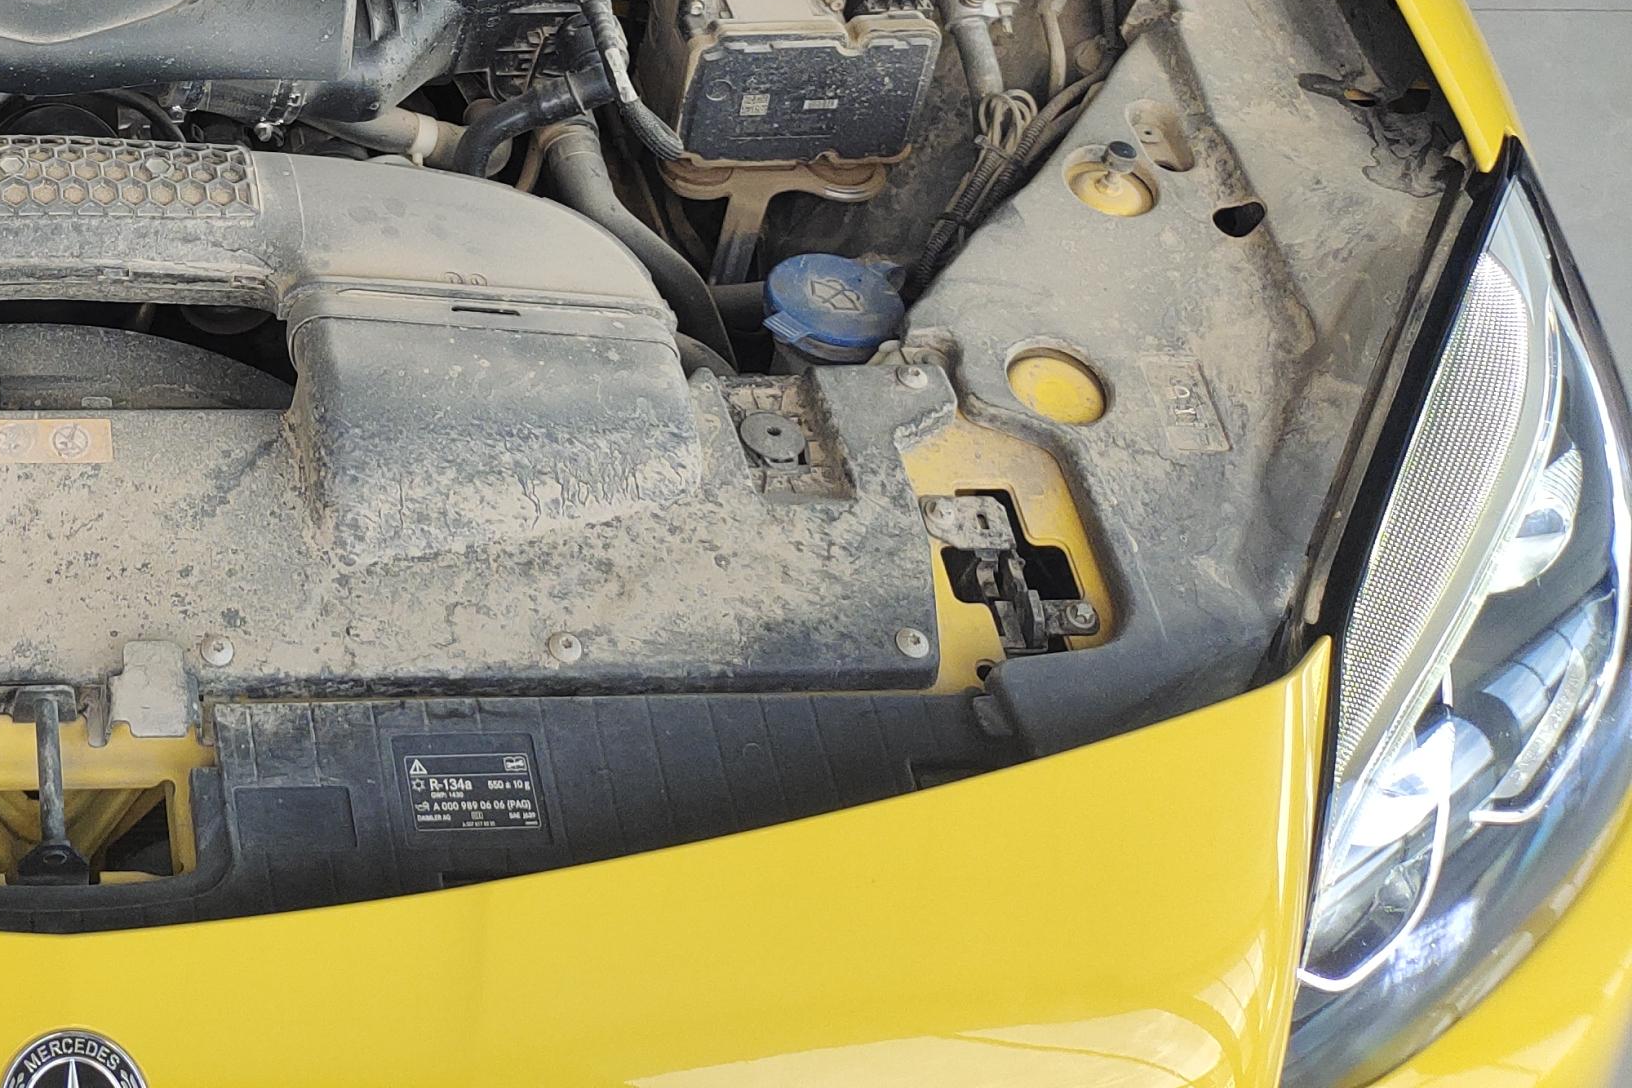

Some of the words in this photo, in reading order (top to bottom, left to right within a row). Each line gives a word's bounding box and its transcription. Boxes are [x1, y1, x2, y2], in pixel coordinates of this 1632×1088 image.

[429, 778, 472, 791] R-134a
[513, 779, 523, 789] 10
[433, 802, 440, 811] A
[442, 801, 459, 810] 000
[460, 801, 478, 810] 989
[480, 800, 491, 810] 06
[493, 800, 505, 810] 06
[506, 799, 531, 811] (PAG)
[23, 1038, 120, 1073] MERCEDES
